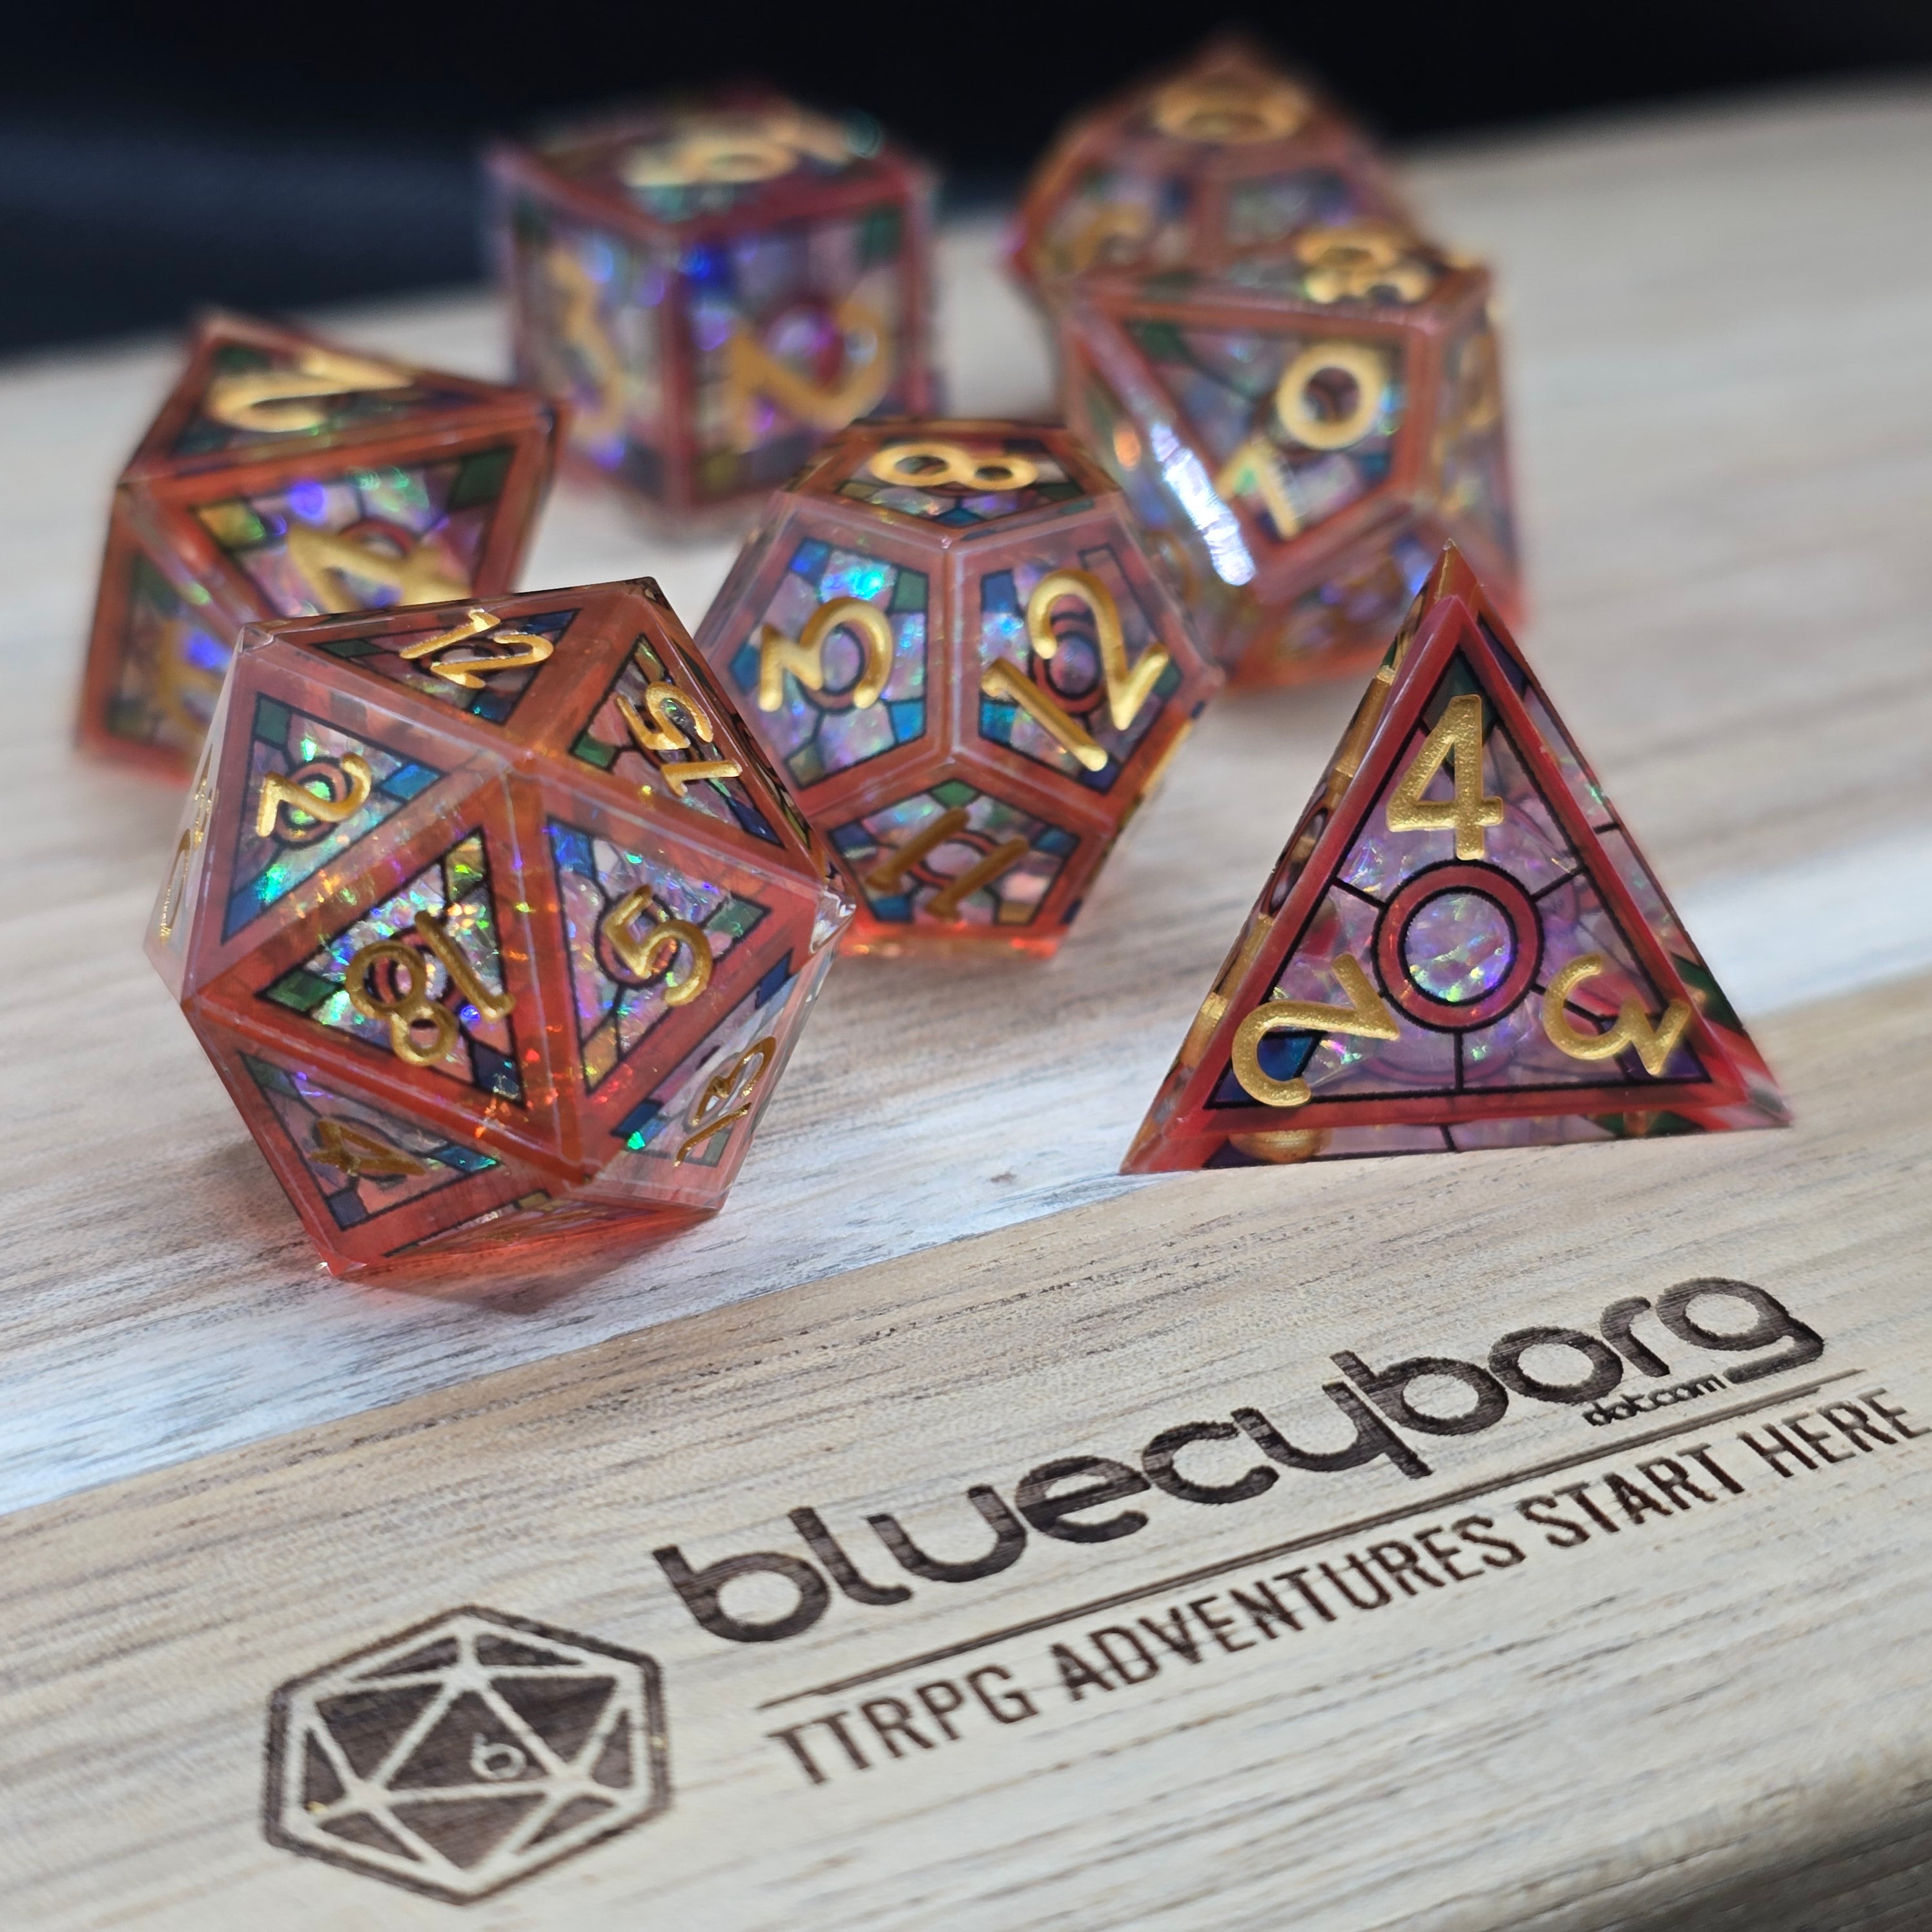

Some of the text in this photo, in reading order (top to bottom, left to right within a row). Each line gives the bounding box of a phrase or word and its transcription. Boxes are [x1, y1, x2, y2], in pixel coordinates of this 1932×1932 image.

[867, 442, 1038, 491] 8
[759, 597, 894, 712] 3
[981, 570, 1170, 771] 12
[257, 752, 371, 837] 2
[616, 681, 743, 797] 15
[1386, 694, 1504, 859] 4
[866, 807, 1032, 920] 11
[345, 909, 516, 1067] 18
[602, 885, 714, 1007] 5
[1233, 953, 1400, 1107] 2
[1544, 953, 1690, 1074] 3
[652, 1277, 1825, 1642] bluecyborg
[1581, 1373, 1727, 1426] dotcom
[767, 1387, 1932, 1785] TTRPG ADVENTURES START HERE
